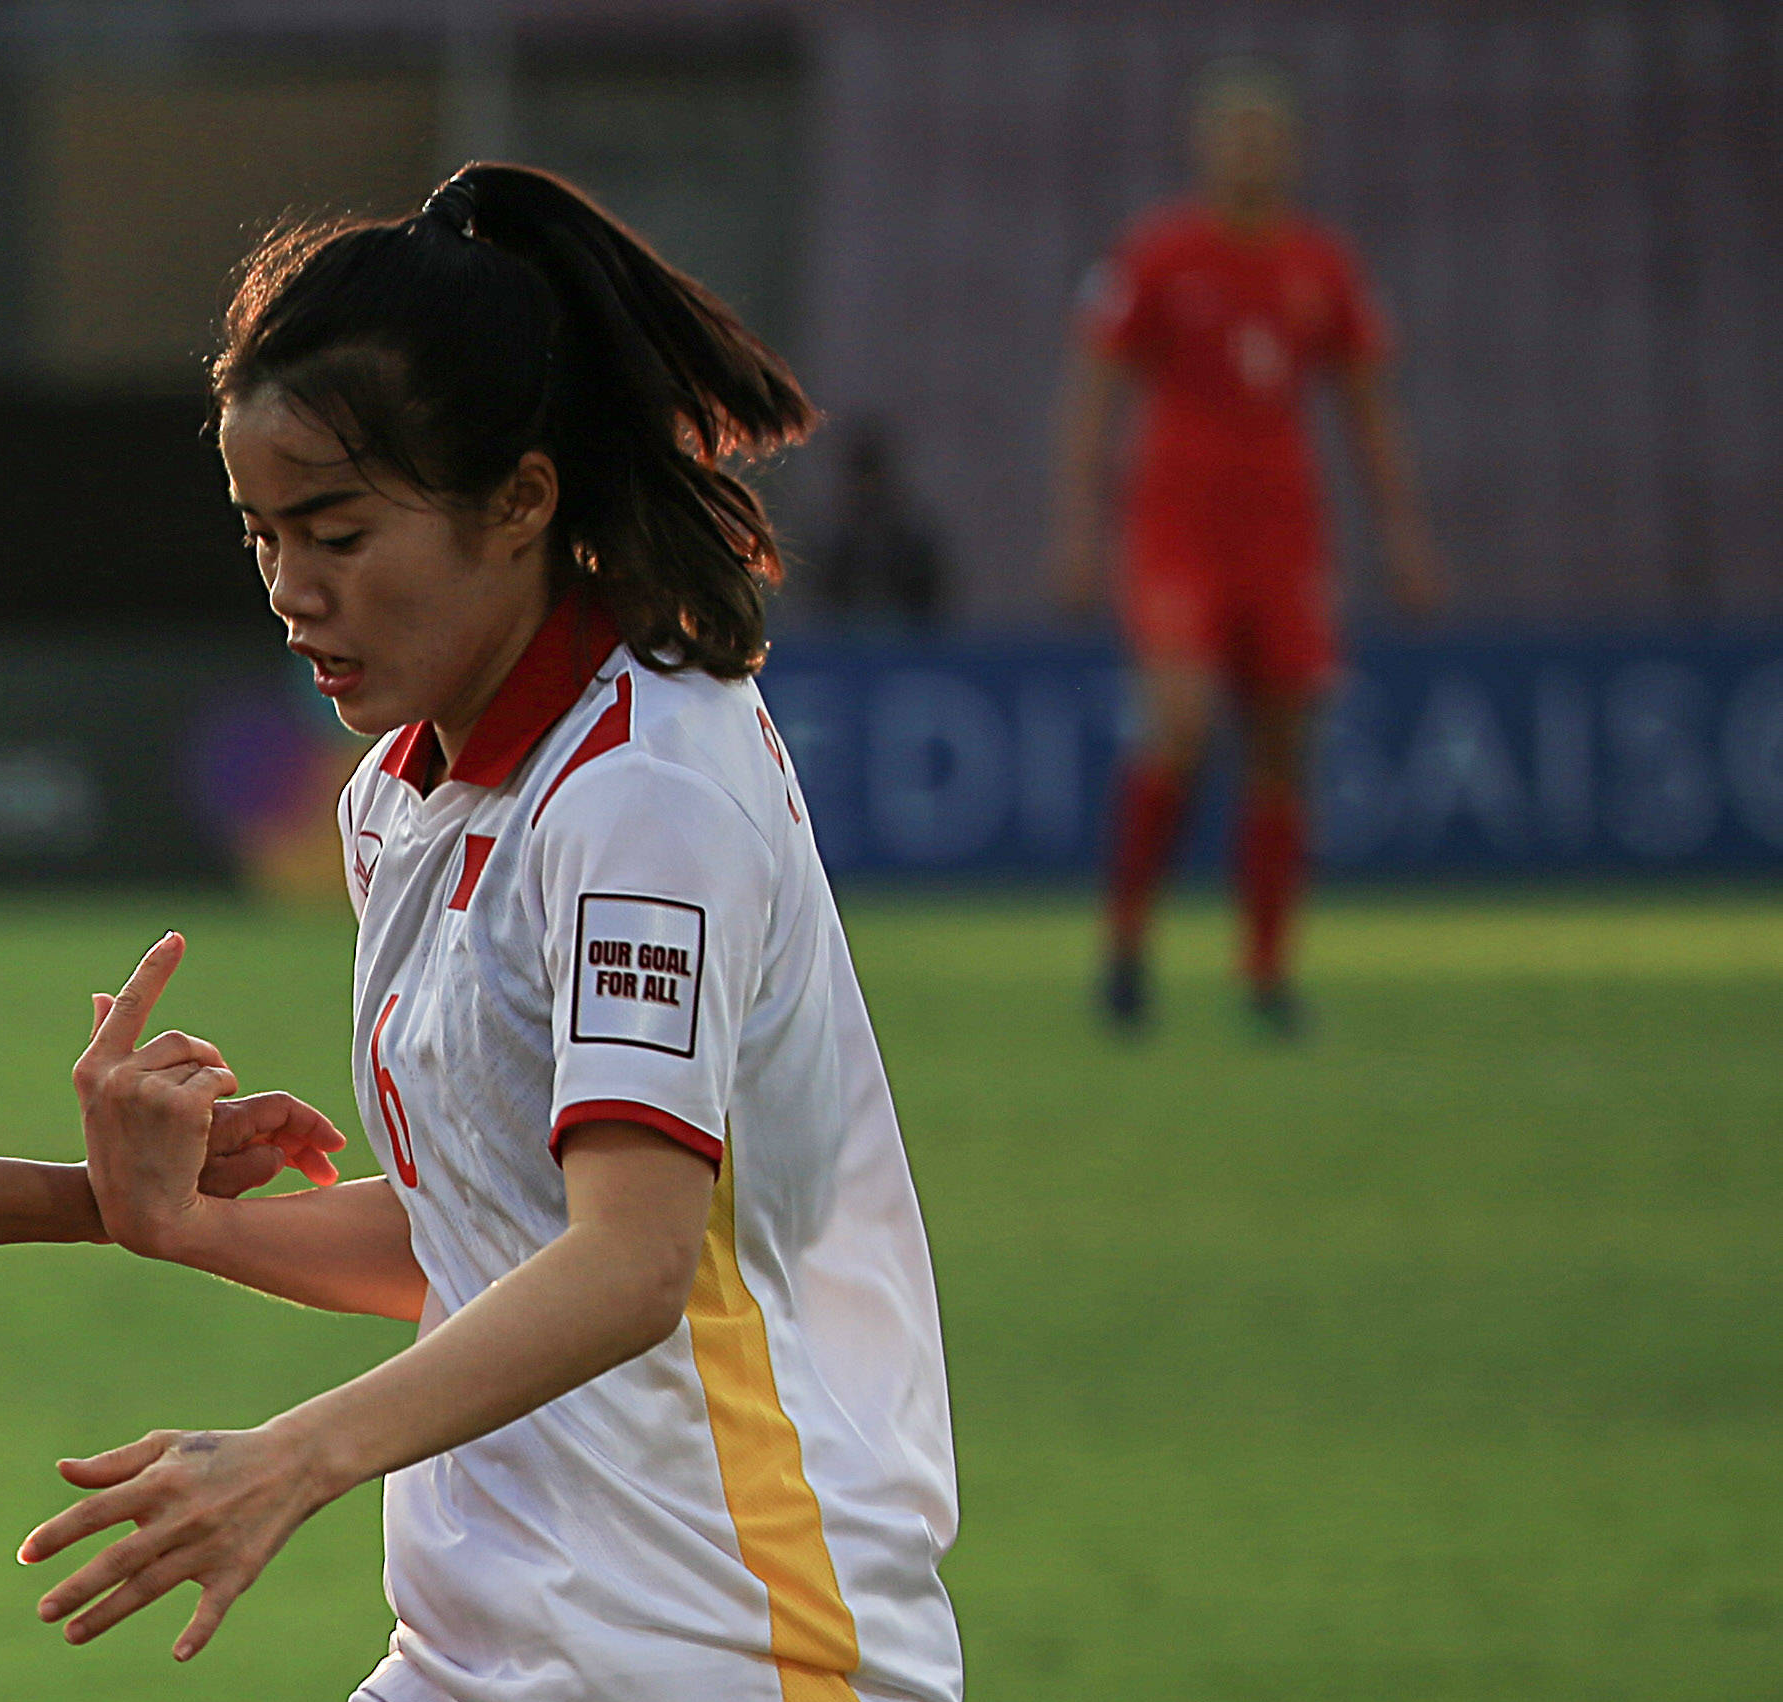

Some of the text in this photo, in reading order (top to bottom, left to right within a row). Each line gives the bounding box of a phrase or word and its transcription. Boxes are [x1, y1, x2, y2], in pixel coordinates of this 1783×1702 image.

[588, 940, 691, 977] OUR GOAL
[596, 970, 680, 1006] FOR ALL
